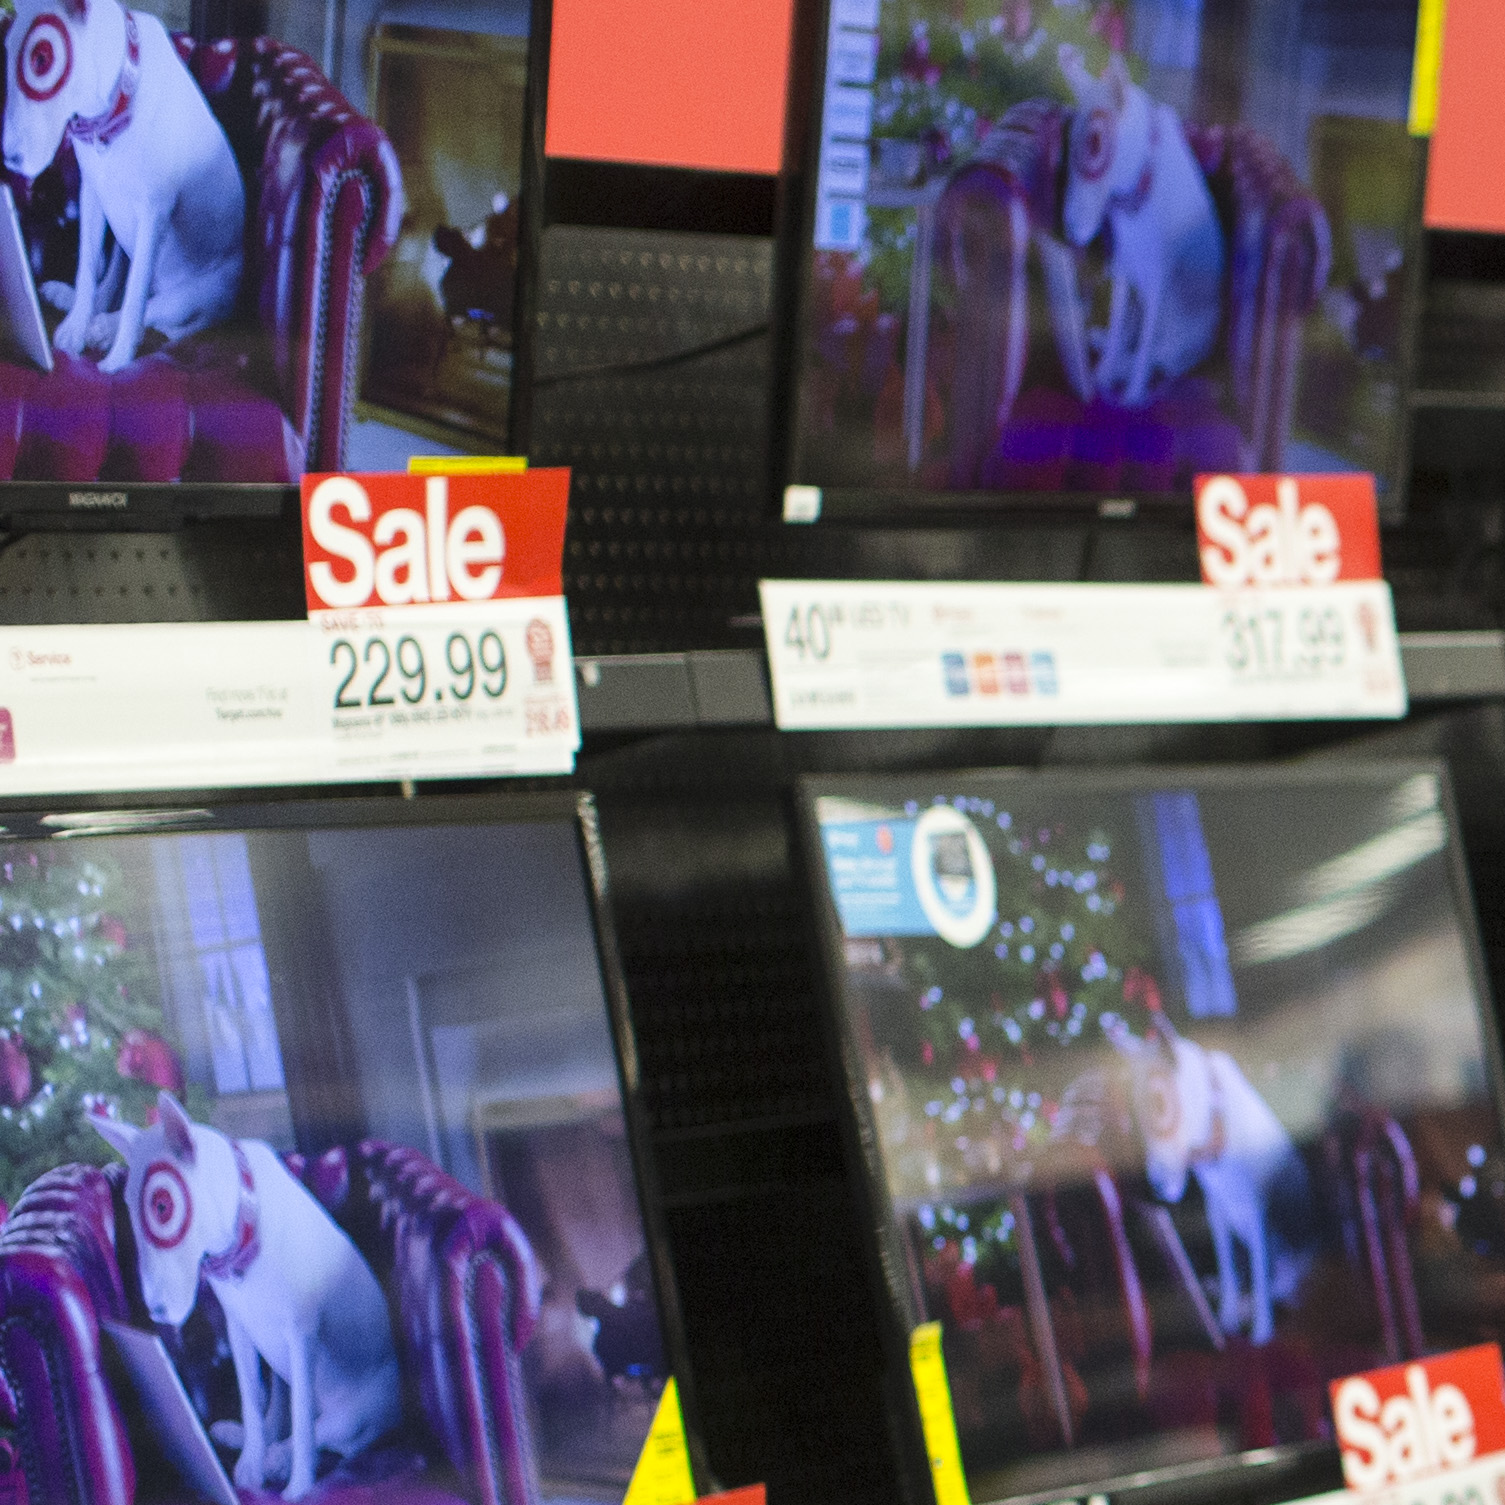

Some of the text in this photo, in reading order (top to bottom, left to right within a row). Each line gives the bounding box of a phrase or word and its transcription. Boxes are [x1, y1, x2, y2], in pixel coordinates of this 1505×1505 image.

[308, 476, 505, 608] Sale
[1200, 474, 1342, 589] Sale
[330, 628, 508, 709] 229.99
[1335, 1364, 1477, 1492] Sale
